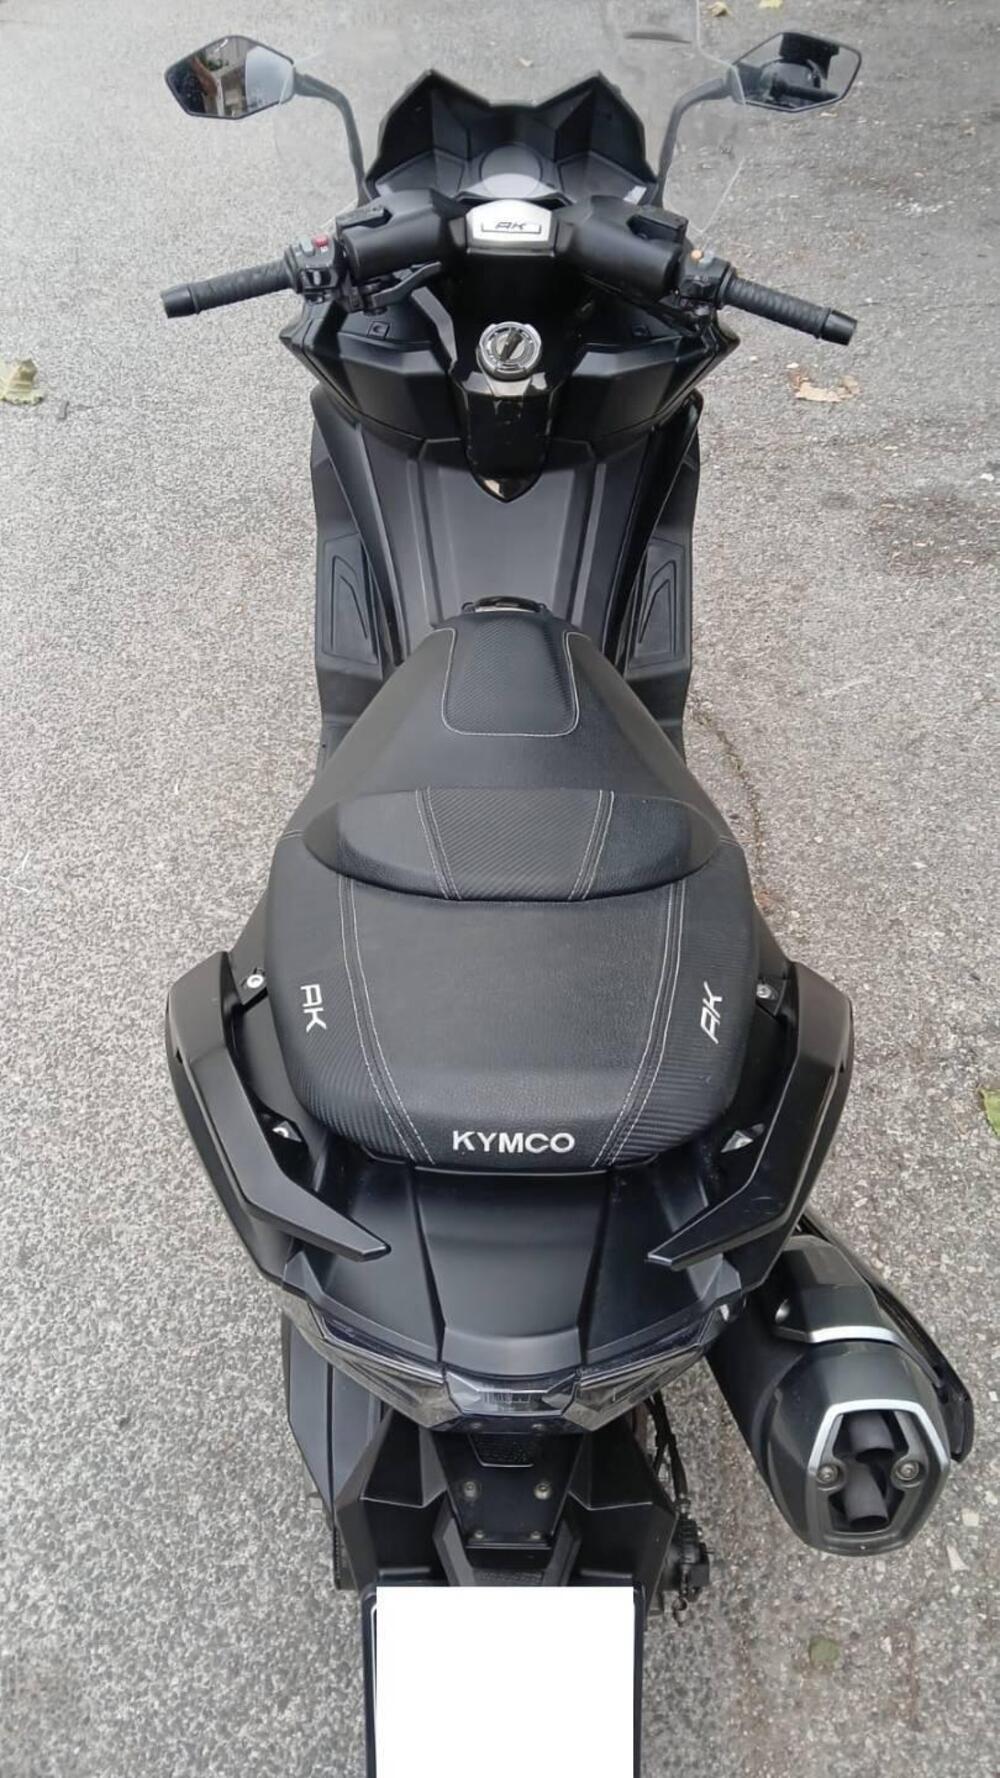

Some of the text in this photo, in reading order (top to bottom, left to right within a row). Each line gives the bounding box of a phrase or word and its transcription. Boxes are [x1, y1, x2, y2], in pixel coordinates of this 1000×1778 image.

[495, 221, 526, 230] AK
[300, 984, 327, 1033] AK
[700, 981, 723, 1045] AK
[452, 1130, 575, 1154] KYMCO
